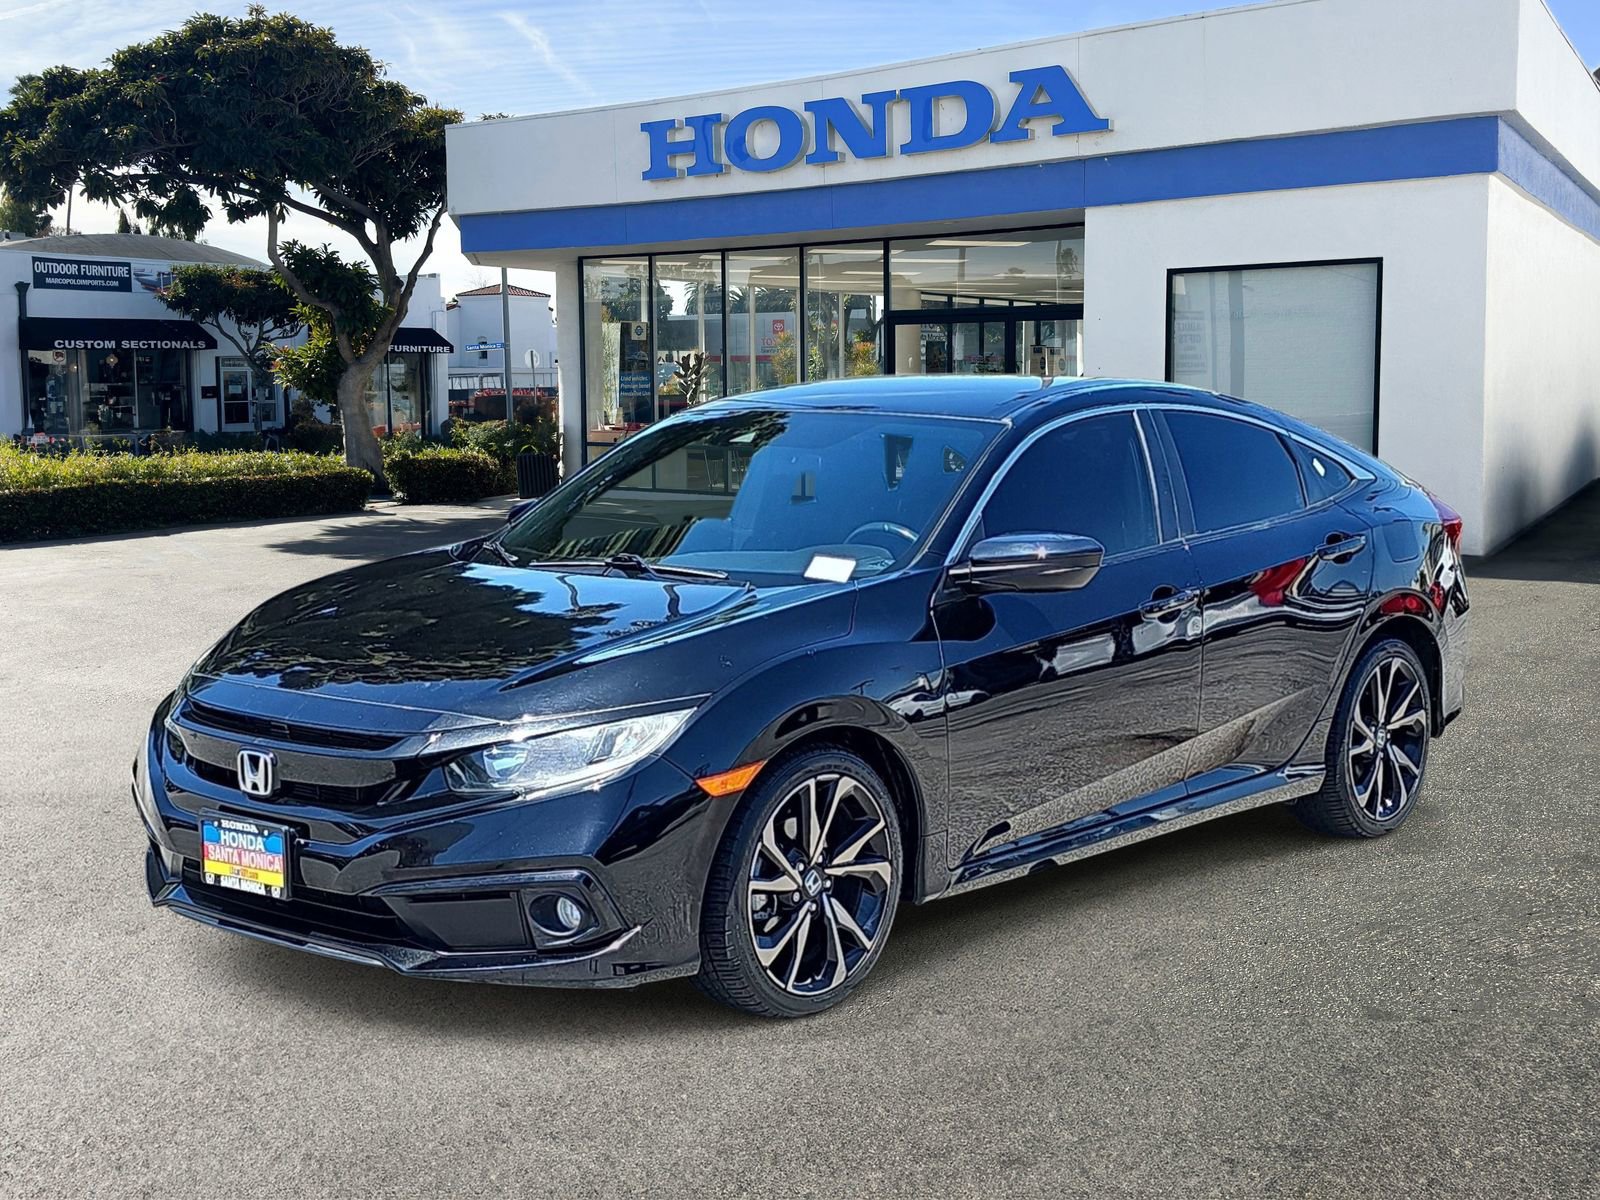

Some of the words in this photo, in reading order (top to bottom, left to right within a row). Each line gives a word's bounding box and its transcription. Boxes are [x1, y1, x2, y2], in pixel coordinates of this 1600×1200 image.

[641, 64, 1112, 182] HONDA
[34, 261, 78, 276] OUTDOOR
[80, 264, 129, 277] FURNITURE
[45, 277, 120, 287] MARCOPOLOIMPORTS.COM
[54, 339, 116, 349] CUSTOM
[121, 340, 206, 349] SECTIONALS
[388, 344, 450, 353] FURNITURE
[220, 819, 259, 833] HONDA
[220, 830, 265, 852] HONDA
[208, 844, 240, 865] SANTA
[240, 851, 282, 872] MONICA
